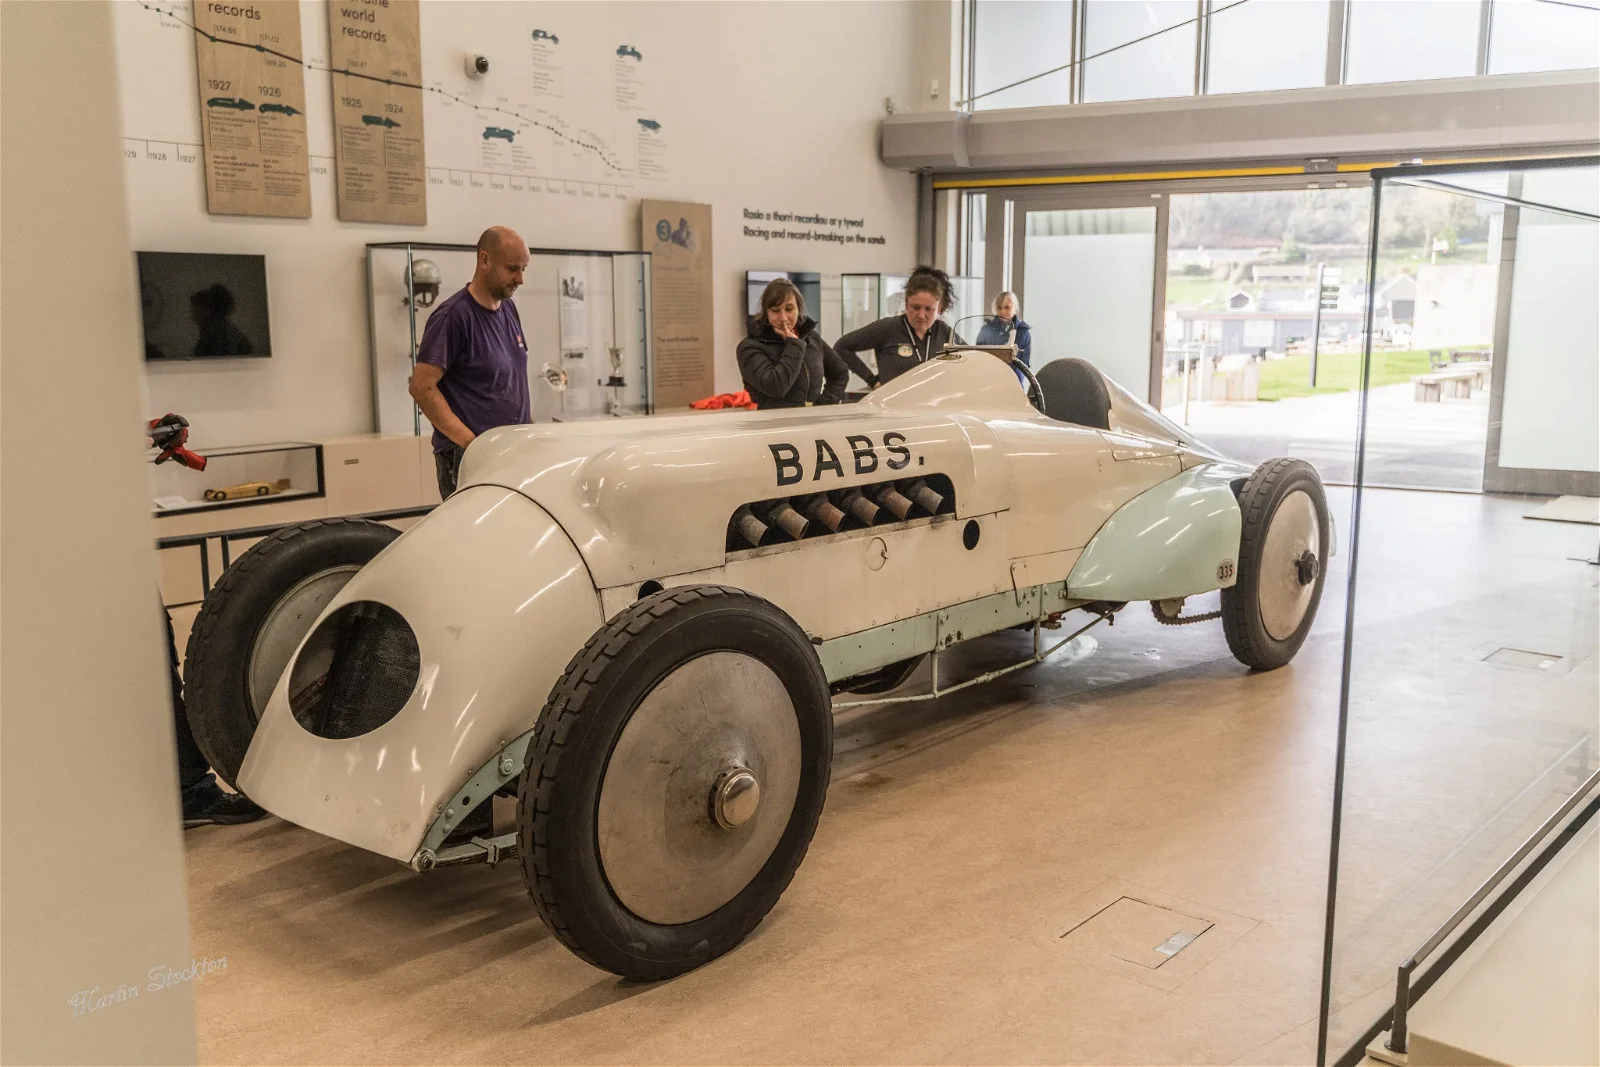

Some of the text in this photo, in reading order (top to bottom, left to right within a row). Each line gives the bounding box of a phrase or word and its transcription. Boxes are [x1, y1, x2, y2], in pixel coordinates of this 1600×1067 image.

[208, 2, 261, 20] records
[341, 8, 375, 23] world
[342, 27, 387, 43] records
[207, 79, 231, 92] 1927
[258, 86, 282, 98] 1926
[341, 97, 362, 108] 1925
[385, 103, 404, 113] 1924
[180, 155, 196, 163] 1927
[743, 208, 764, 220] Rasio
[773, 211, 793, 222] thorri
[795, 214, 828, 225] recordiau
[829, 218, 837, 226] ar
[838, 219, 843, 229] y
[844, 216, 864, 230] tywod
[743, 225, 886, 246] Racing and record-breaking on the sands
[768, 431, 925, 487] BABS.
[1219, 564, 1233, 580] 335
